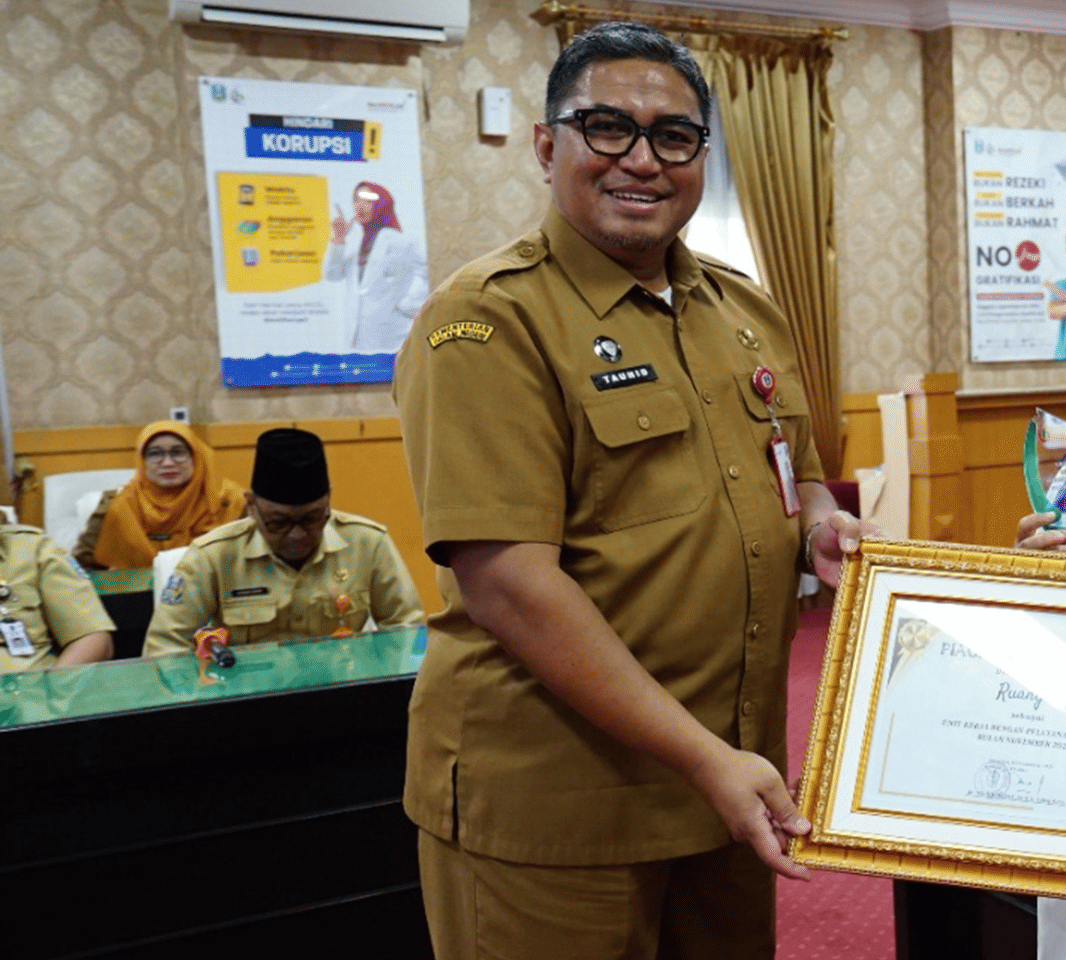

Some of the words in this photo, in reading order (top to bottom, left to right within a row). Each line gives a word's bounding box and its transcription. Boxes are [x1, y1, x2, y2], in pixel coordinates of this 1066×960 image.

[262, 133, 352, 154] KORUPSI
[1005, 176, 1046, 189] REZEKI
[1006, 196, 1055, 208] BERKAH
[1006, 217, 1058, 228] RAHMAT
[976, 246, 1012, 267] NO
[976, 274, 1042, 285] GRATIFIKASI
[602, 368, 649, 384] TAUHID
[995, 681, 1043, 709] Ruang
